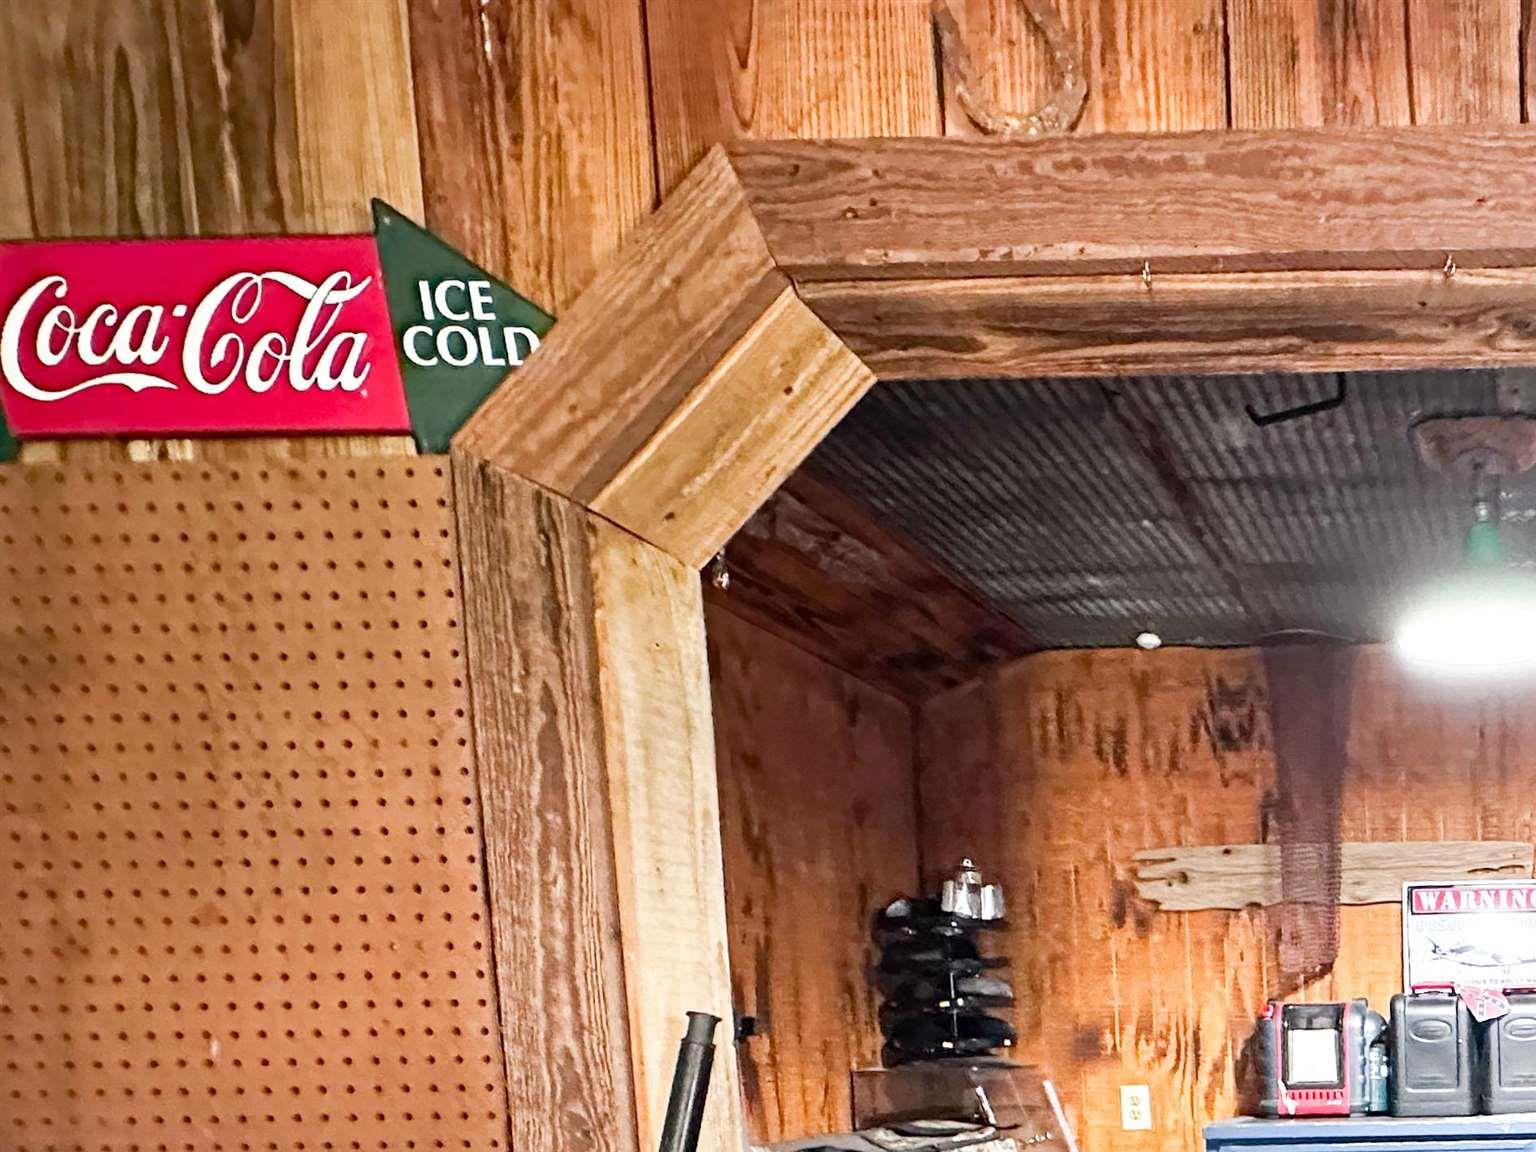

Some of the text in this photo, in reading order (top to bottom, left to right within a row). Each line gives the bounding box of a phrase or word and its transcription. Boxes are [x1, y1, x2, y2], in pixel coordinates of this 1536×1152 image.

[419, 279, 497, 322] ICE
[1, 271, 373, 401] Coca-Cola
[403, 324, 540, 368] COLD
